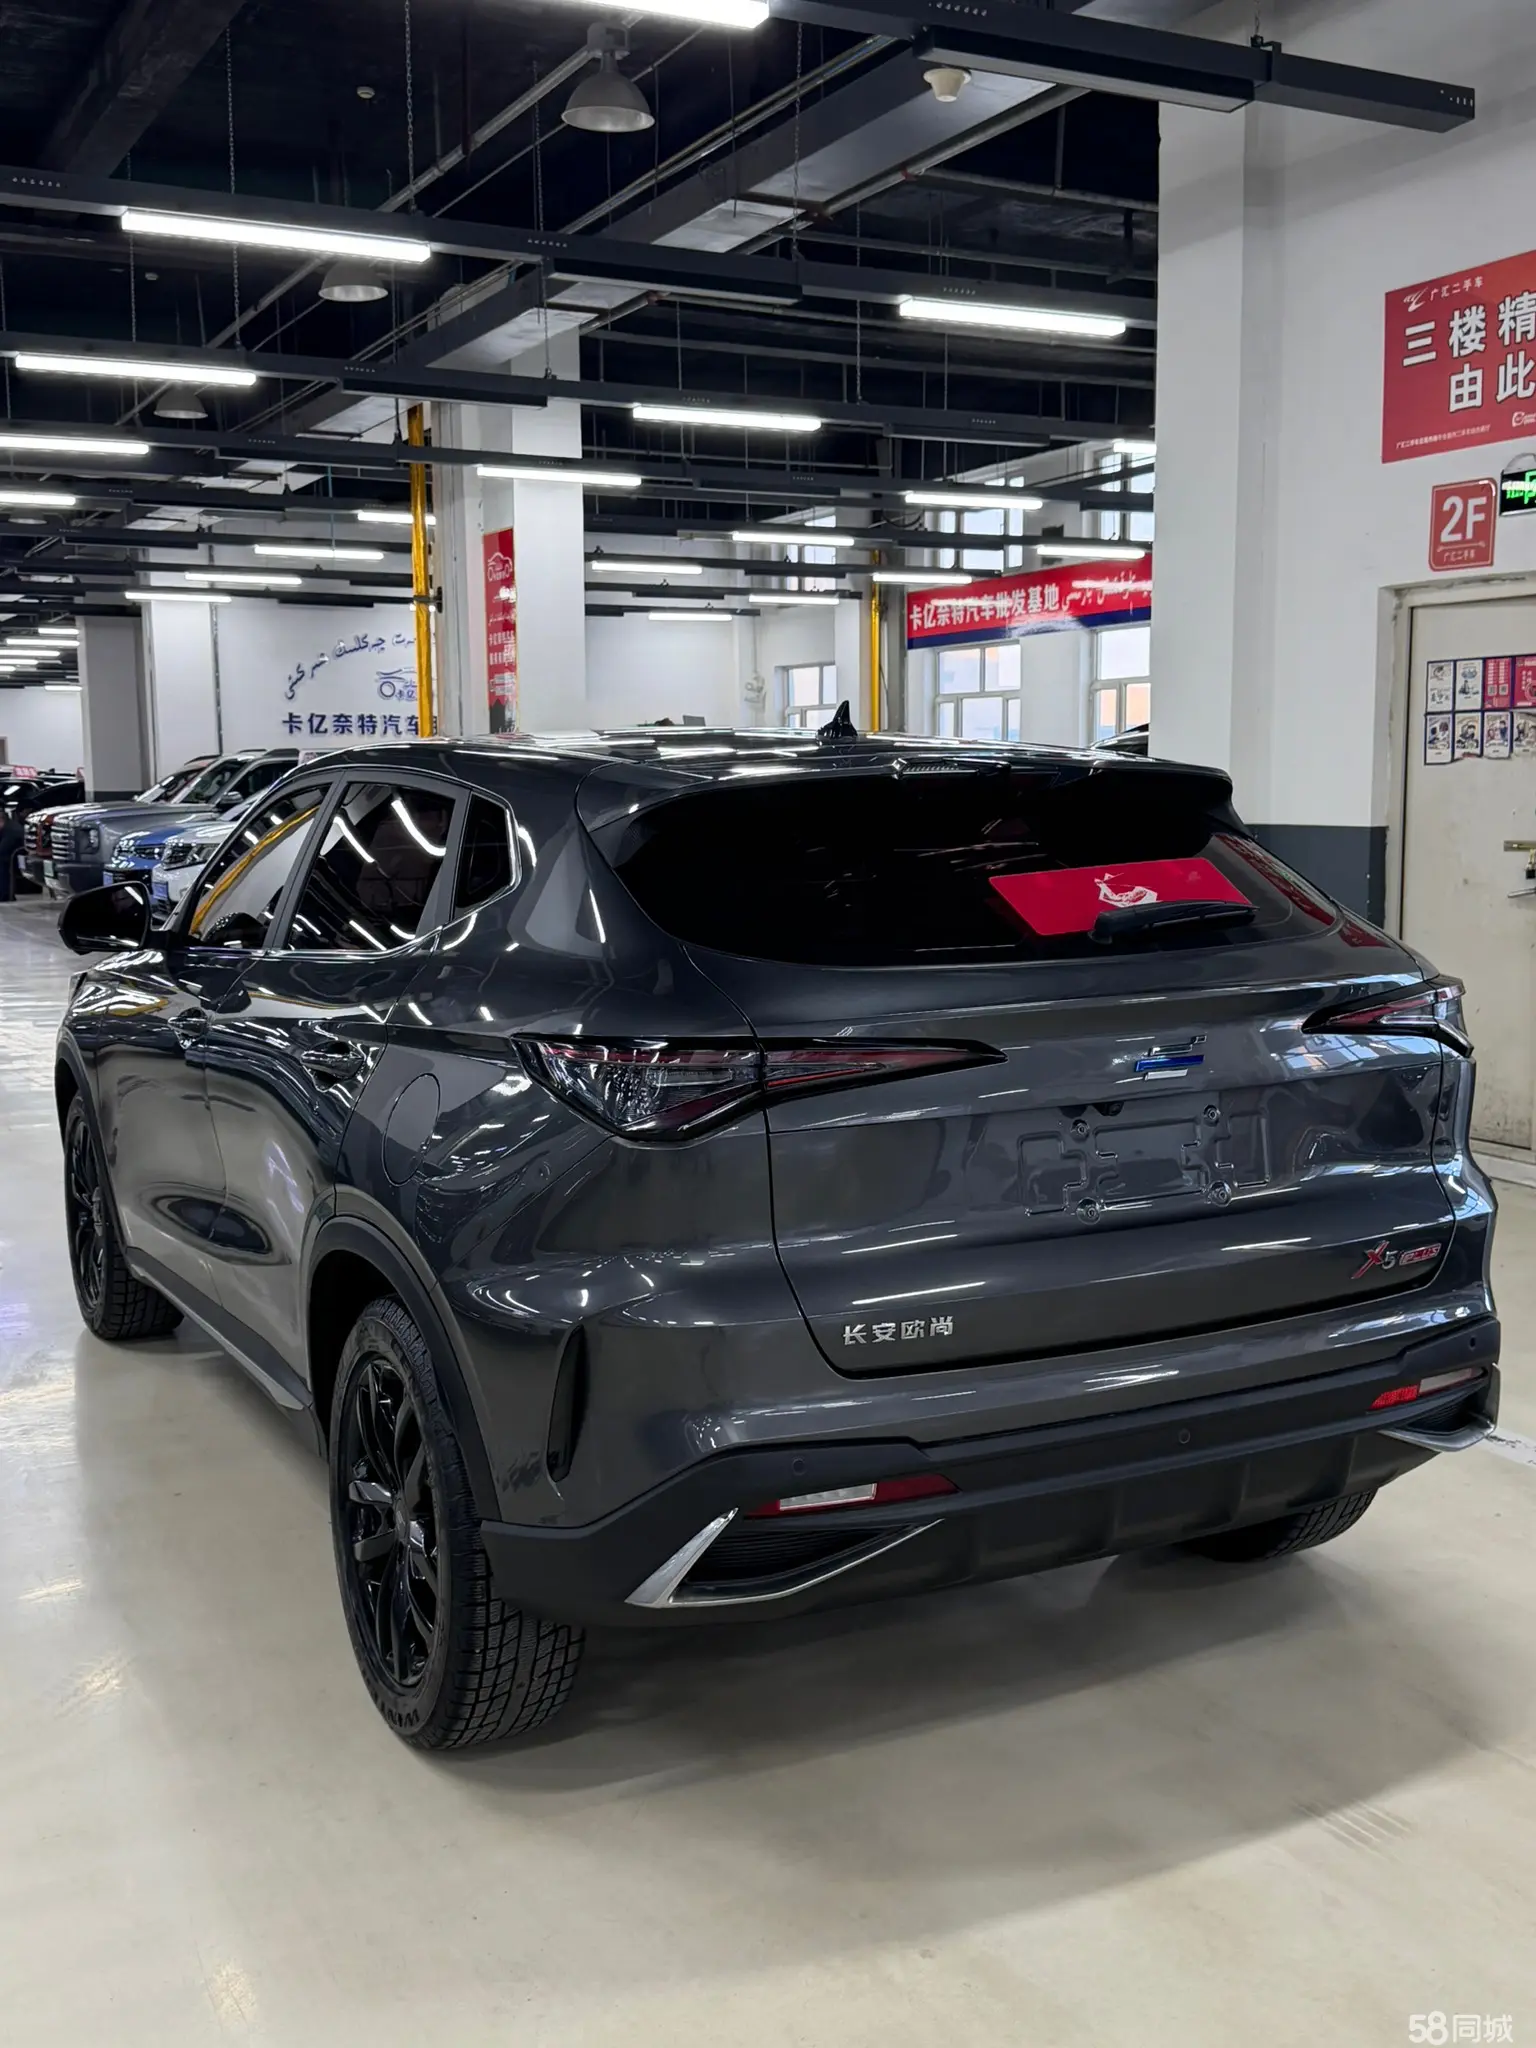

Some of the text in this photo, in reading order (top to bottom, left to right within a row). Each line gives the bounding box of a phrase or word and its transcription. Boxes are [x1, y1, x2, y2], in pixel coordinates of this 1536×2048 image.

[1430, 276, 1485, 301] 广汇二手车
[1402, 291, 1536, 368] 三楼精
[1448, 350, 1536, 413] 由此
[1440, 495, 1488, 543] 2F
[282, 711, 438, 736] 卡亿奈特汽车
[843, 1315, 954, 1346] 长安欧尚
